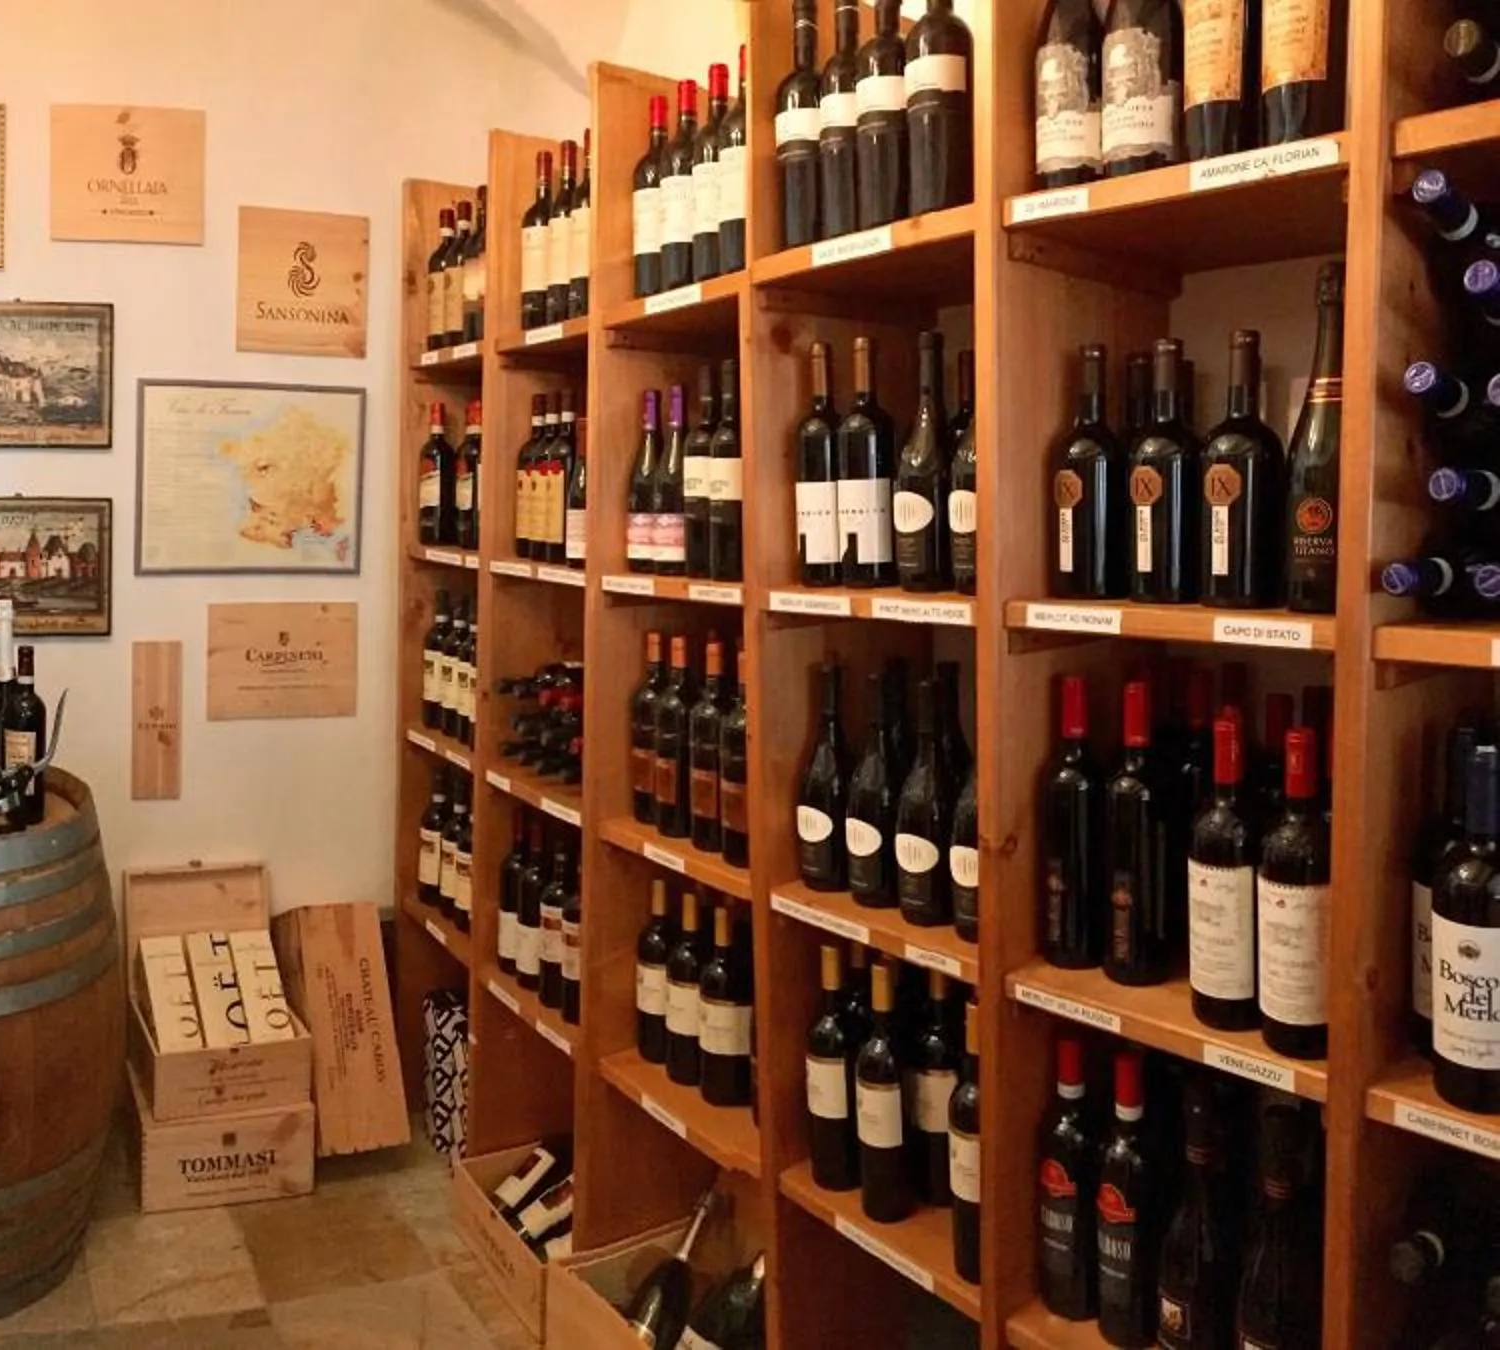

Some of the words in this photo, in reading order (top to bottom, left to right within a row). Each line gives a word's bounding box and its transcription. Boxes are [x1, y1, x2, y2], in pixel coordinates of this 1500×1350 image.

[1199, 162, 1251, 181] AMARONE
[1272, 148, 1320, 166] FLORIAN
[255, 301, 350, 326] SANSONINA
[1136, 477, 1153, 498] IX
[1211, 476, 1232, 497] IX
[1223, 624, 1251, 637] CAPO
[1253, 627, 1264, 638] DI
[1266, 628, 1301, 642] STATO
[1438, 958, 1500, 989] Bosco
[1462, 981, 1493, 1005] del
[1406, 1110, 1470, 1144] CABERNET
[178, 1149, 277, 1175] TOMMASI
